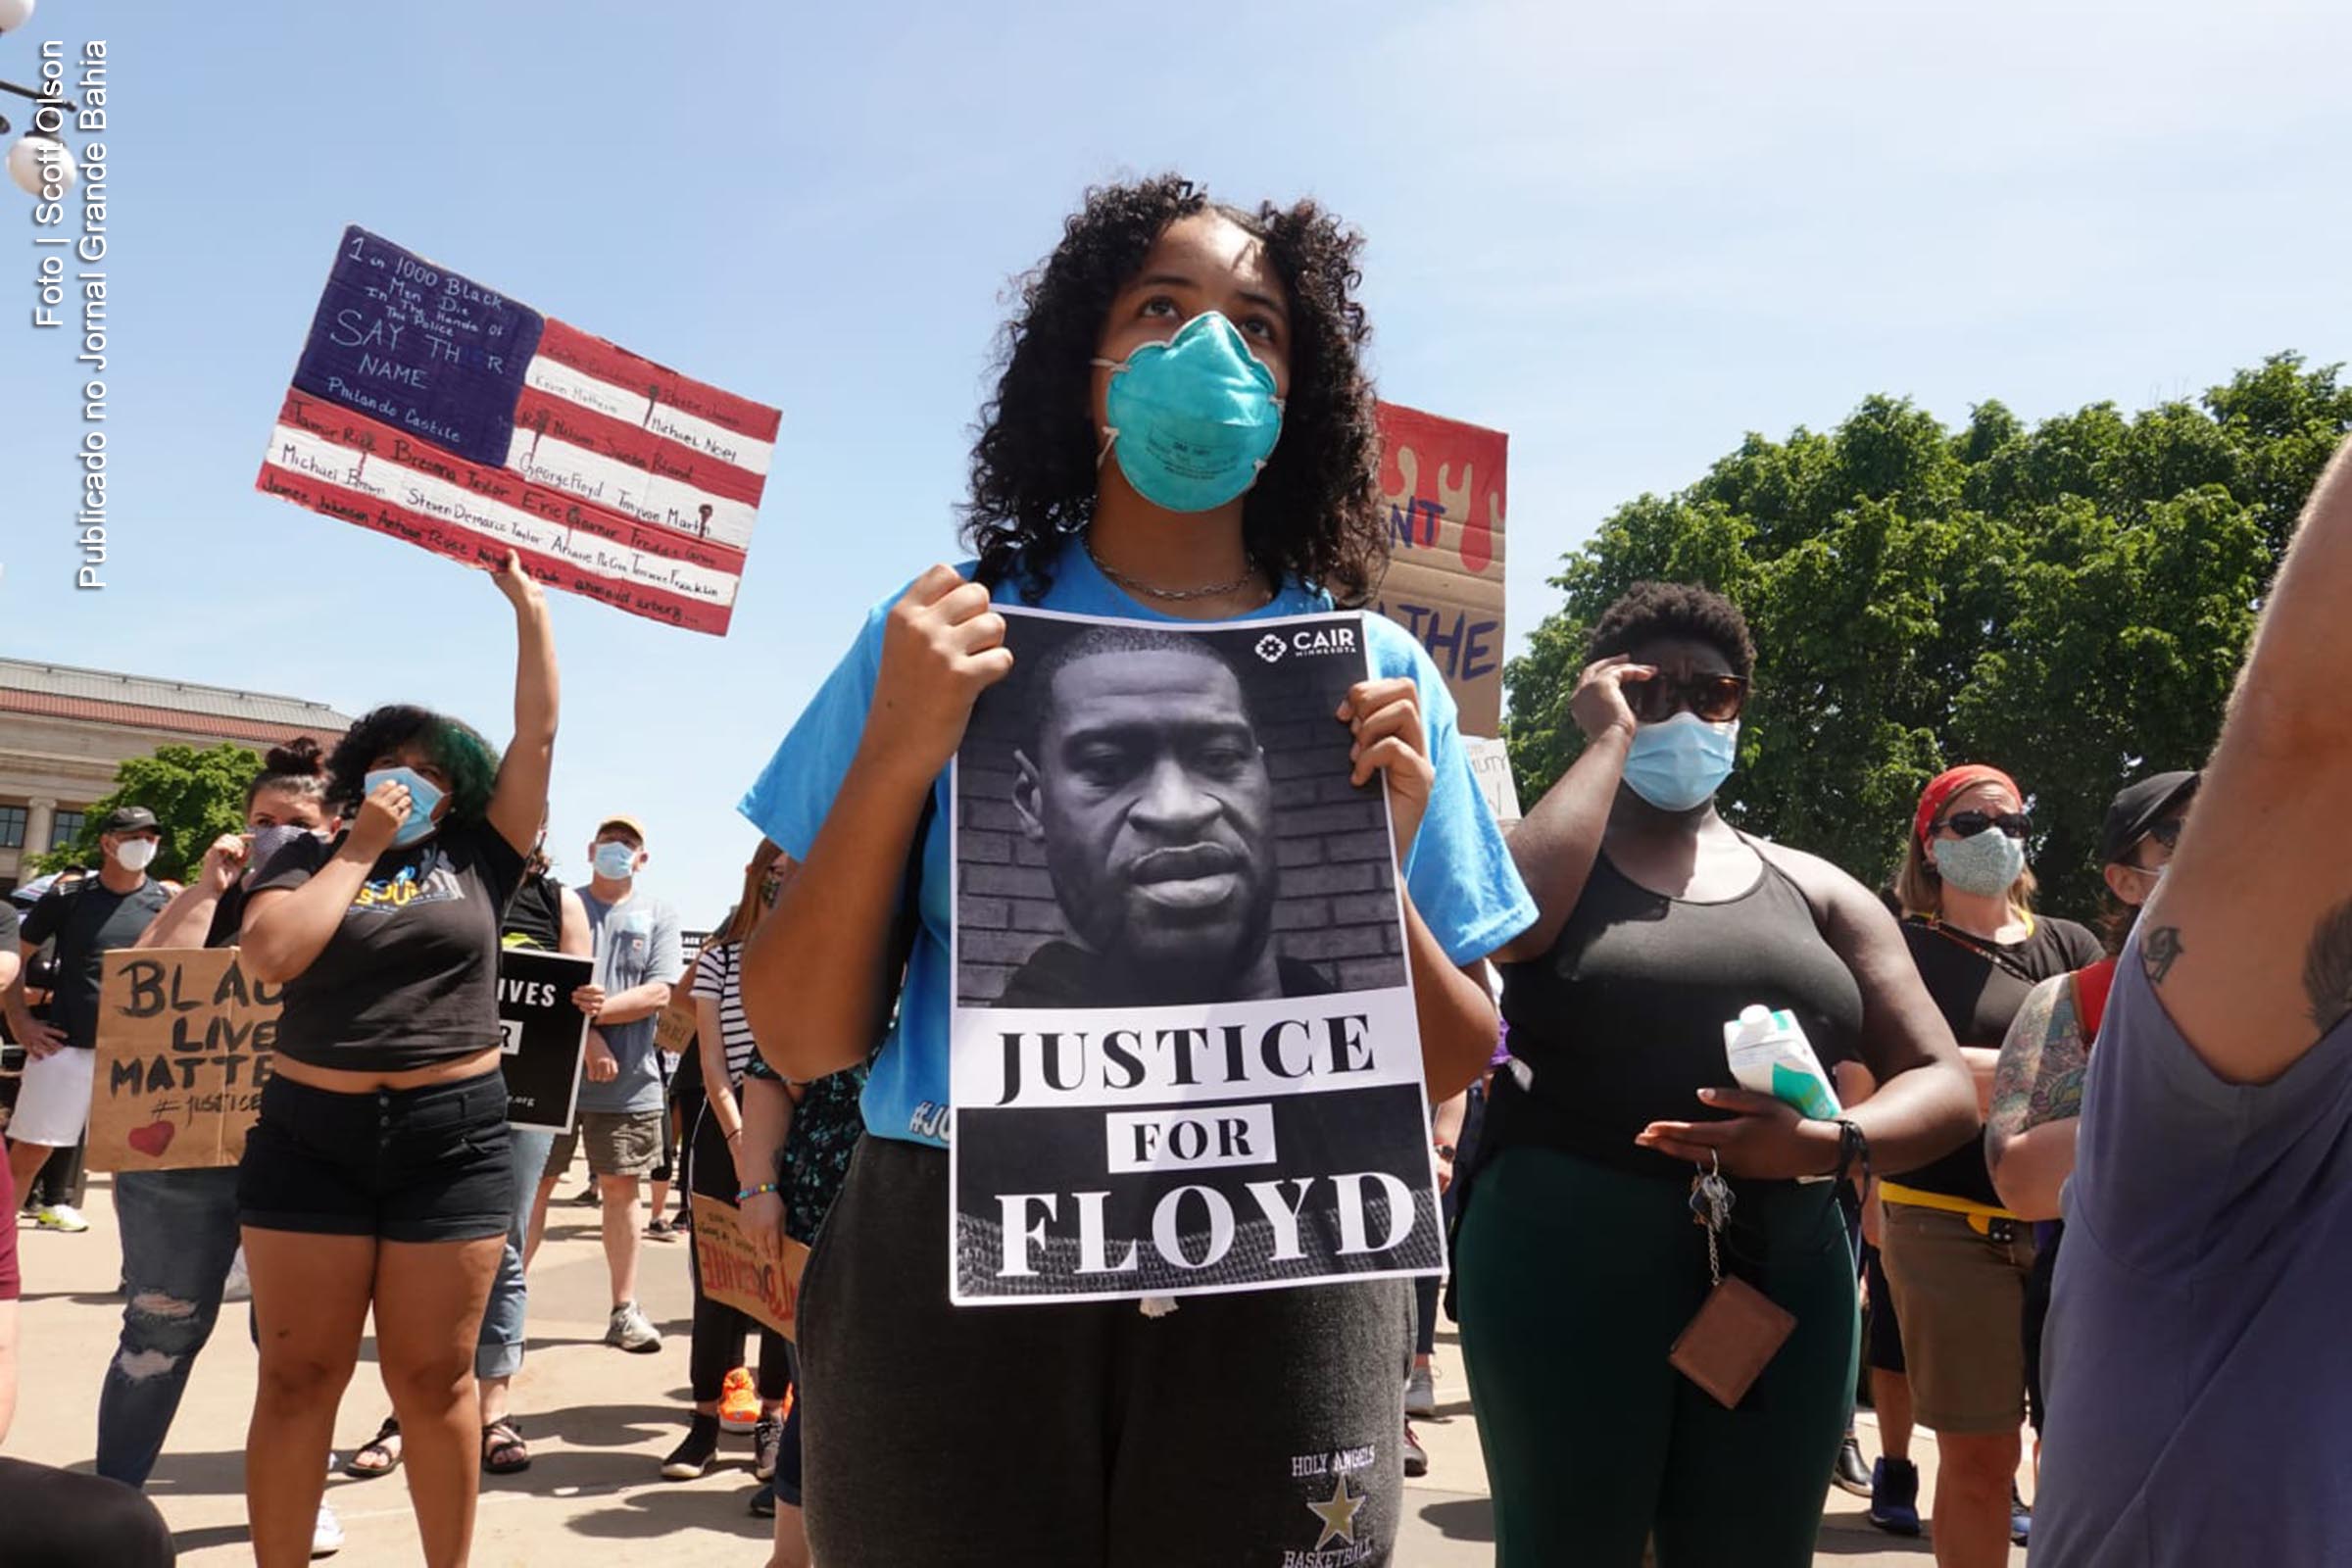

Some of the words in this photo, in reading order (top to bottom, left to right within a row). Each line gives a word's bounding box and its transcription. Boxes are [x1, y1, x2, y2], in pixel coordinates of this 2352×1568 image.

[348, 236, 366, 263] 1
[394, 255, 439, 287] 1000
[445, 276, 504, 311] Black
[329, 308, 405, 353] SAY
[413, 313, 455, 338] Police
[358, 352, 428, 391] NAME
[326, 375, 398, 418] Philando
[405, 409, 462, 443] Castile
[521, 490, 562, 519] Eric
[1293, 627, 1354, 650] CAIR
[1295, 646, 1357, 658] MINNESOTA
[996, 1013, 1375, 1106] JUSTICE
[1132, 1117, 1254, 1163] FOR
[994, 1171, 1417, 1278] FLOYD
[1291, 1452, 1329, 1477] HOLY
[1333, 1445, 1376, 1472] ANGELS
[1281, 1536, 1373, 1568] BASKETBALL
